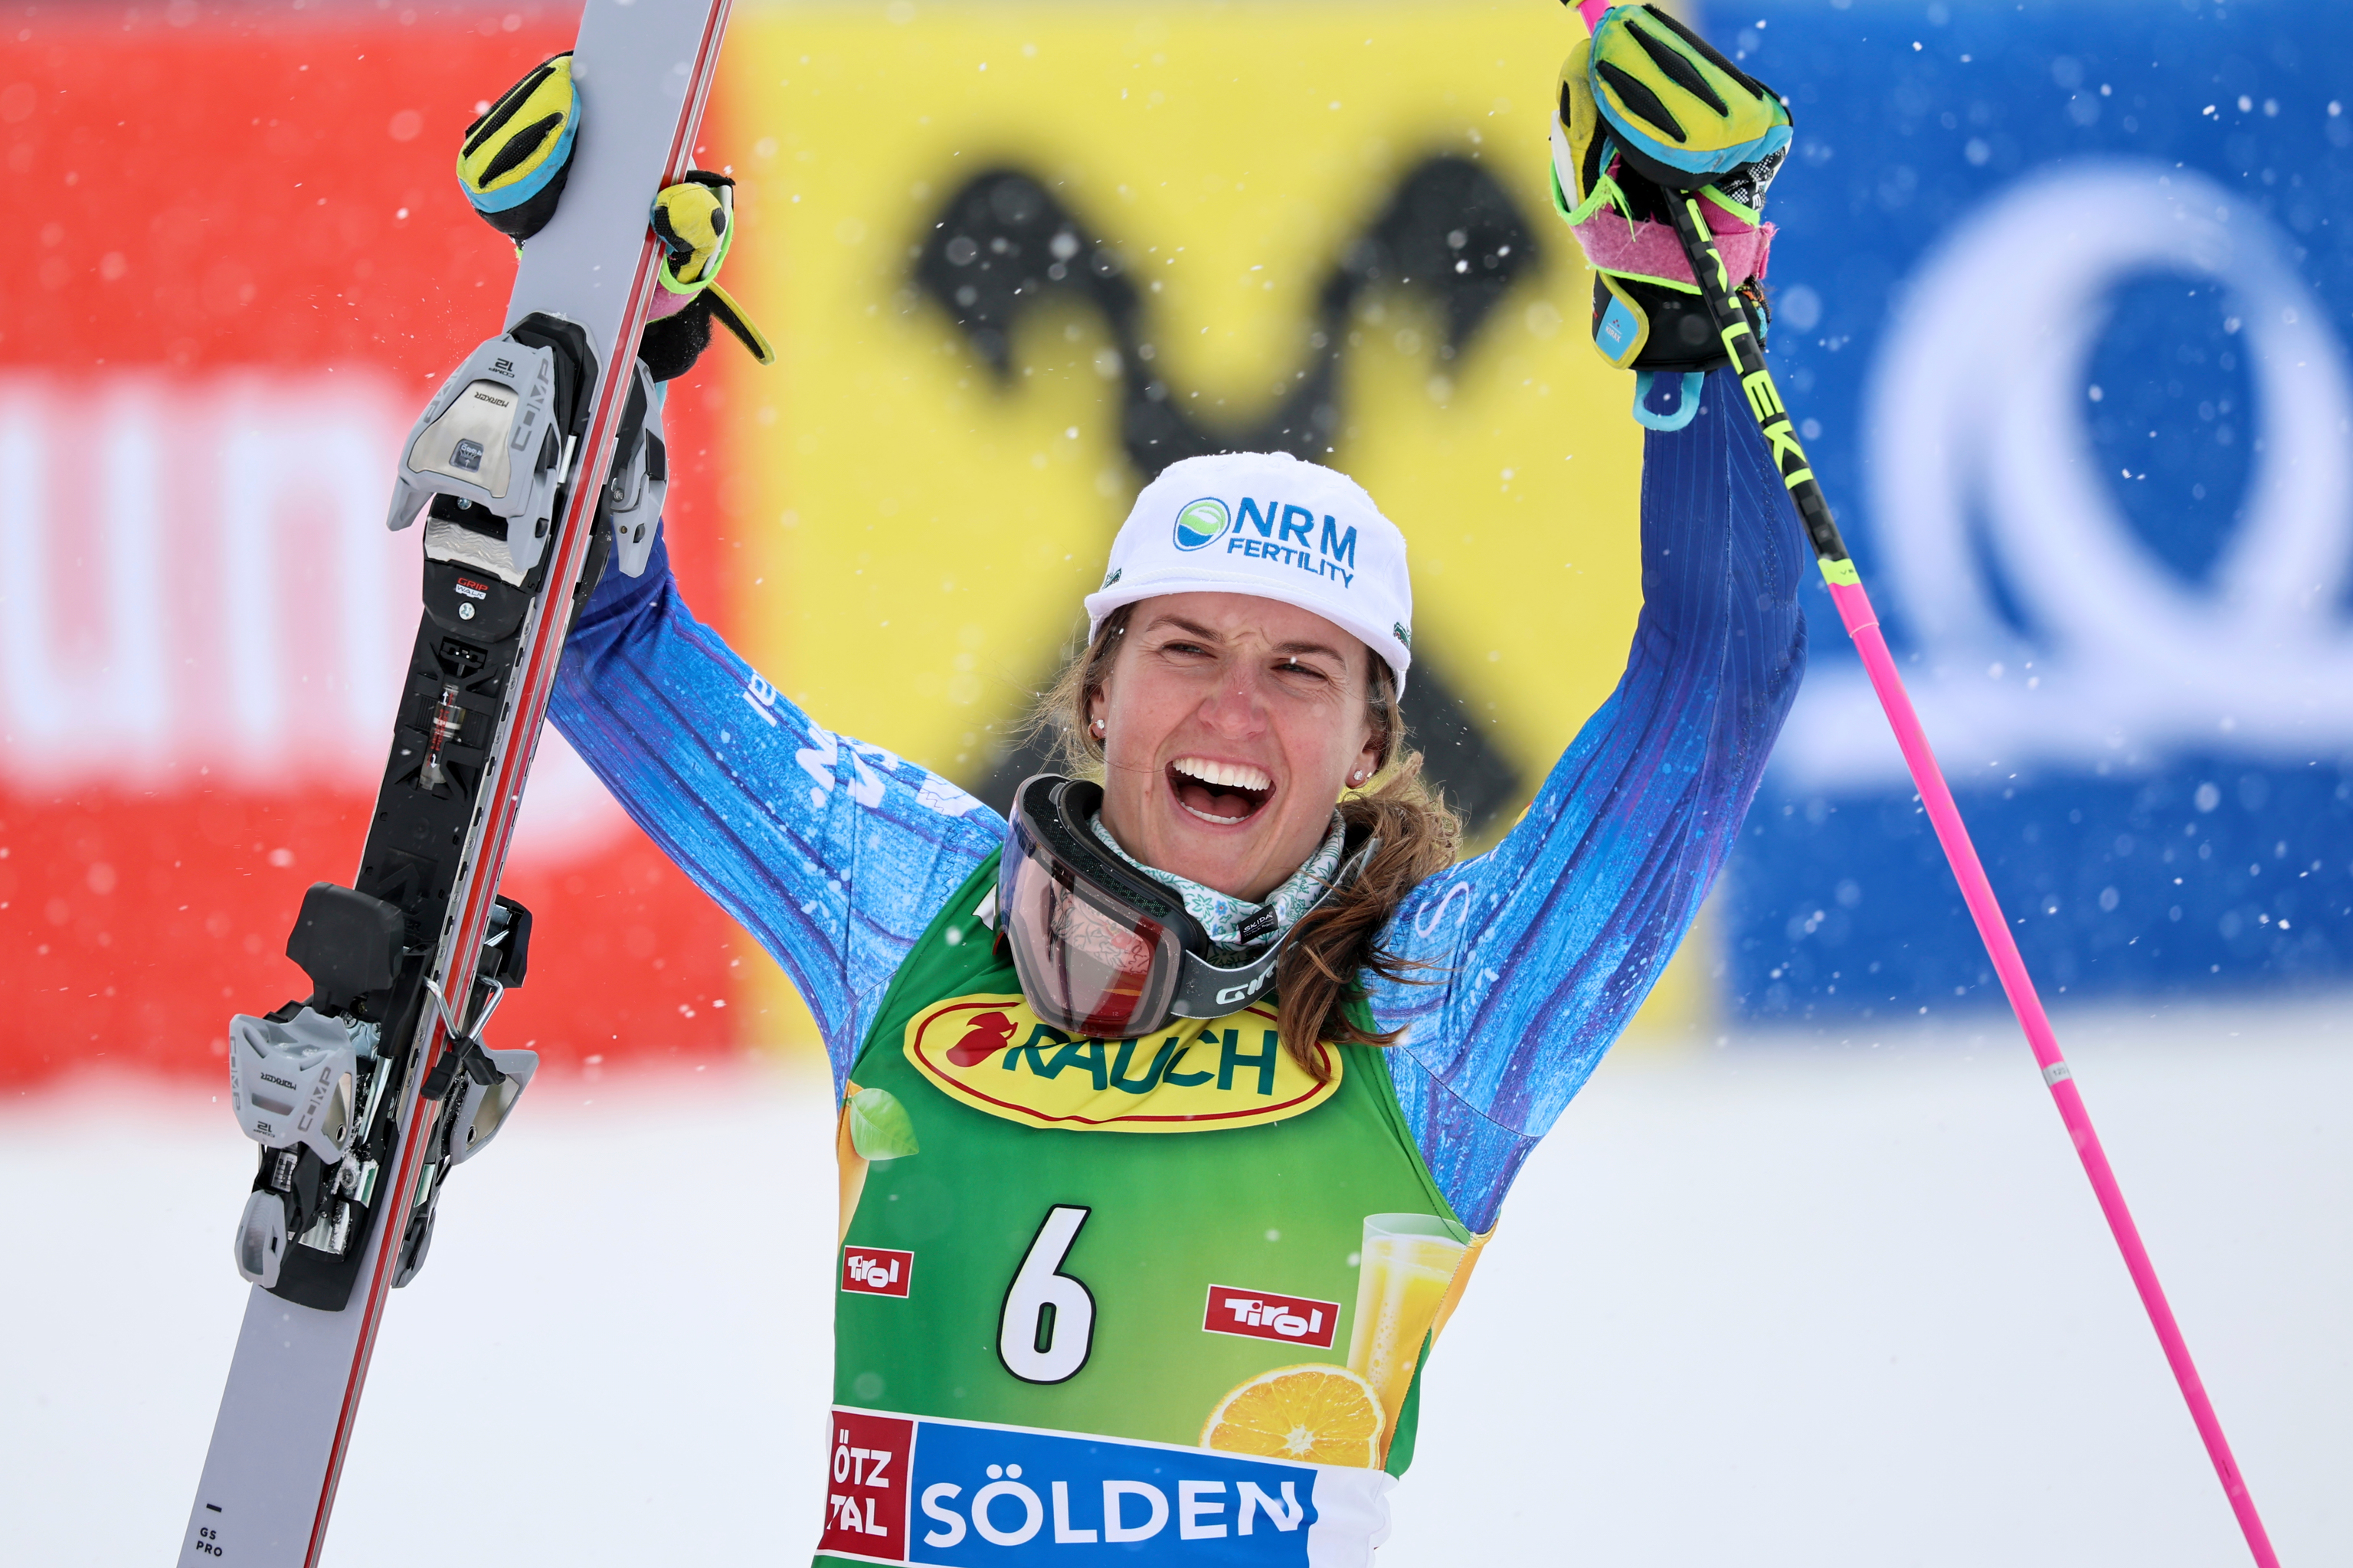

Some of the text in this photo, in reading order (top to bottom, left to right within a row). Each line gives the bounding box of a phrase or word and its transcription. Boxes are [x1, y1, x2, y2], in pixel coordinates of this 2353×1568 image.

[488, 367, 515, 378] COMP
[495, 358, 514, 372] 12
[473, 391, 510, 408] MARKER
[1720, 321, 1815, 491] LEKI
[1231, 496, 1358, 570] NRM
[1226, 538, 1355, 589] FERTILITY
[457, 577, 489, 591] GRIP
[457, 584, 486, 598] WALK
[1242, 912, 1274, 933] SKIDA
[1001, 1023, 1280, 1096] RAUCH
[260, 1072, 297, 1091] MARKER
[257, 1121, 273, 1133] 12
[847, 1255, 900, 1288] Tirol
[996, 1203, 1097, 1386] 6
[1224, 1298, 1324, 1338] Tirol
[833, 1428, 892, 1488] ÖTZ
[826, 1493, 889, 1538] TAL
[920, 1462, 1304, 1549] SÖLDEN
[200, 1527, 218, 1540] GS
[195, 1540, 223, 1557] PRO
